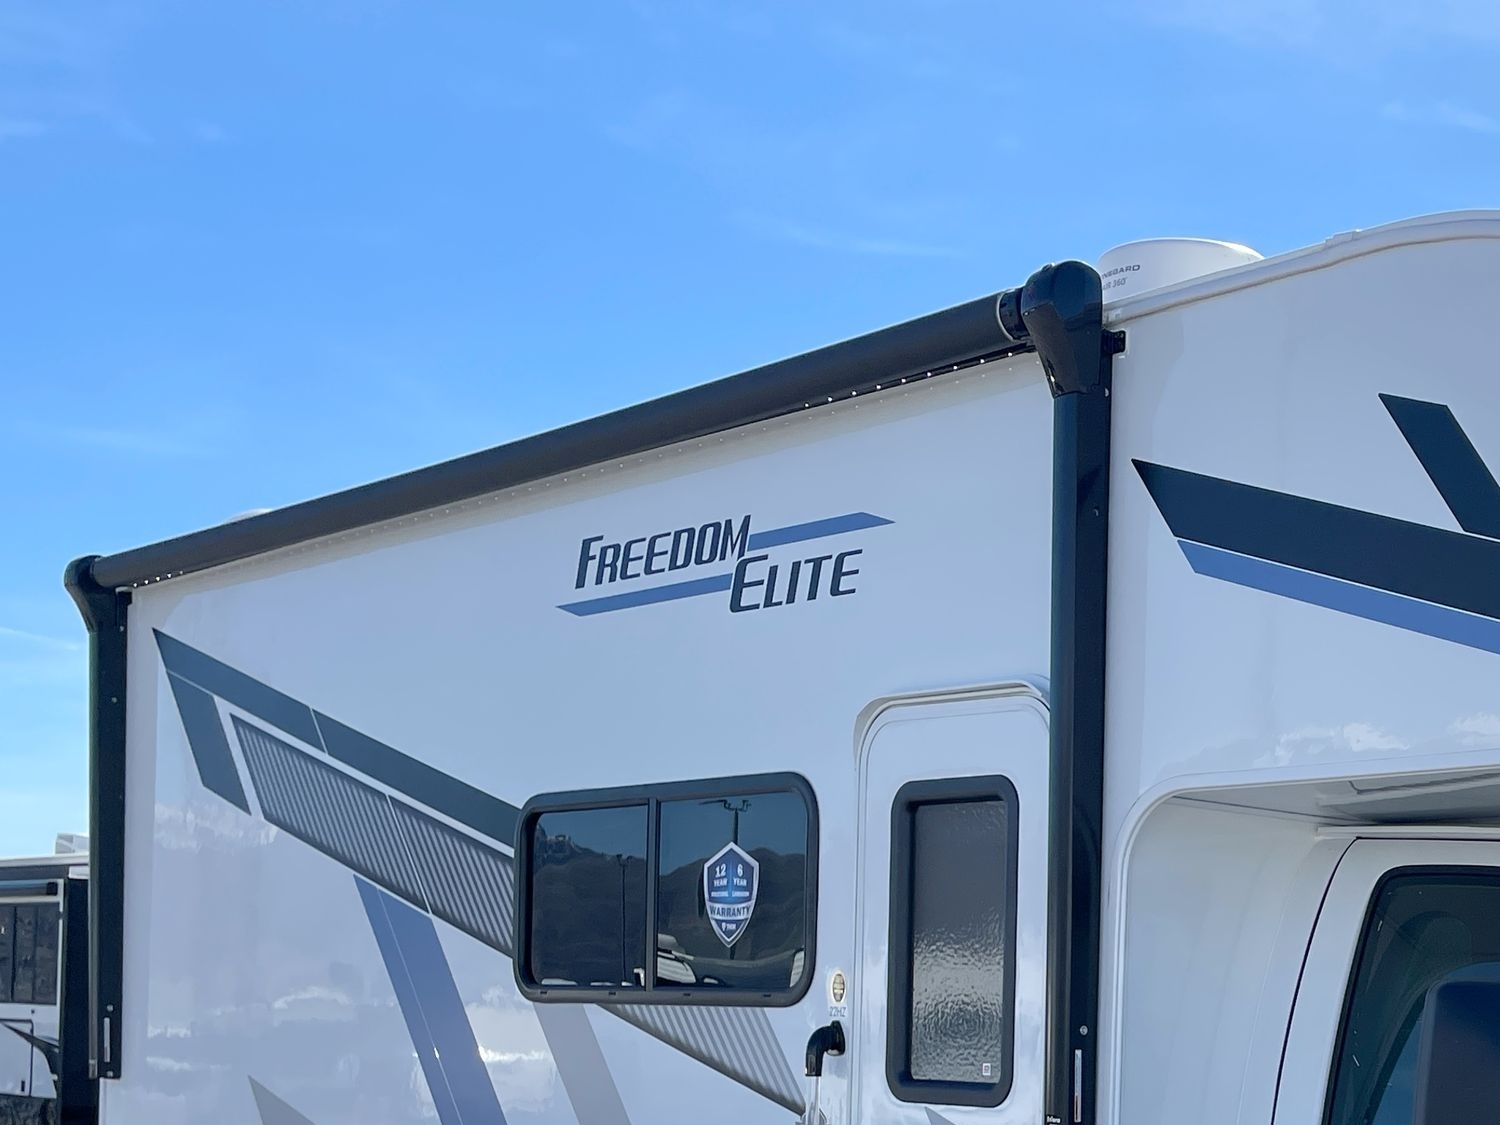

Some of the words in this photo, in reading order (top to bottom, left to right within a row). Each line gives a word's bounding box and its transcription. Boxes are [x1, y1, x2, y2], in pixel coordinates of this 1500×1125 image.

[574, 513, 752, 590] FREEDOM
[729, 548, 864, 613] ELITE
[714, 863, 727, 878] 12
[737, 863, 744, 878] 6
[713, 878, 728, 888] YEAR
[733, 877, 747, 887] YEAR
[709, 905, 751, 918] WARRANTY
